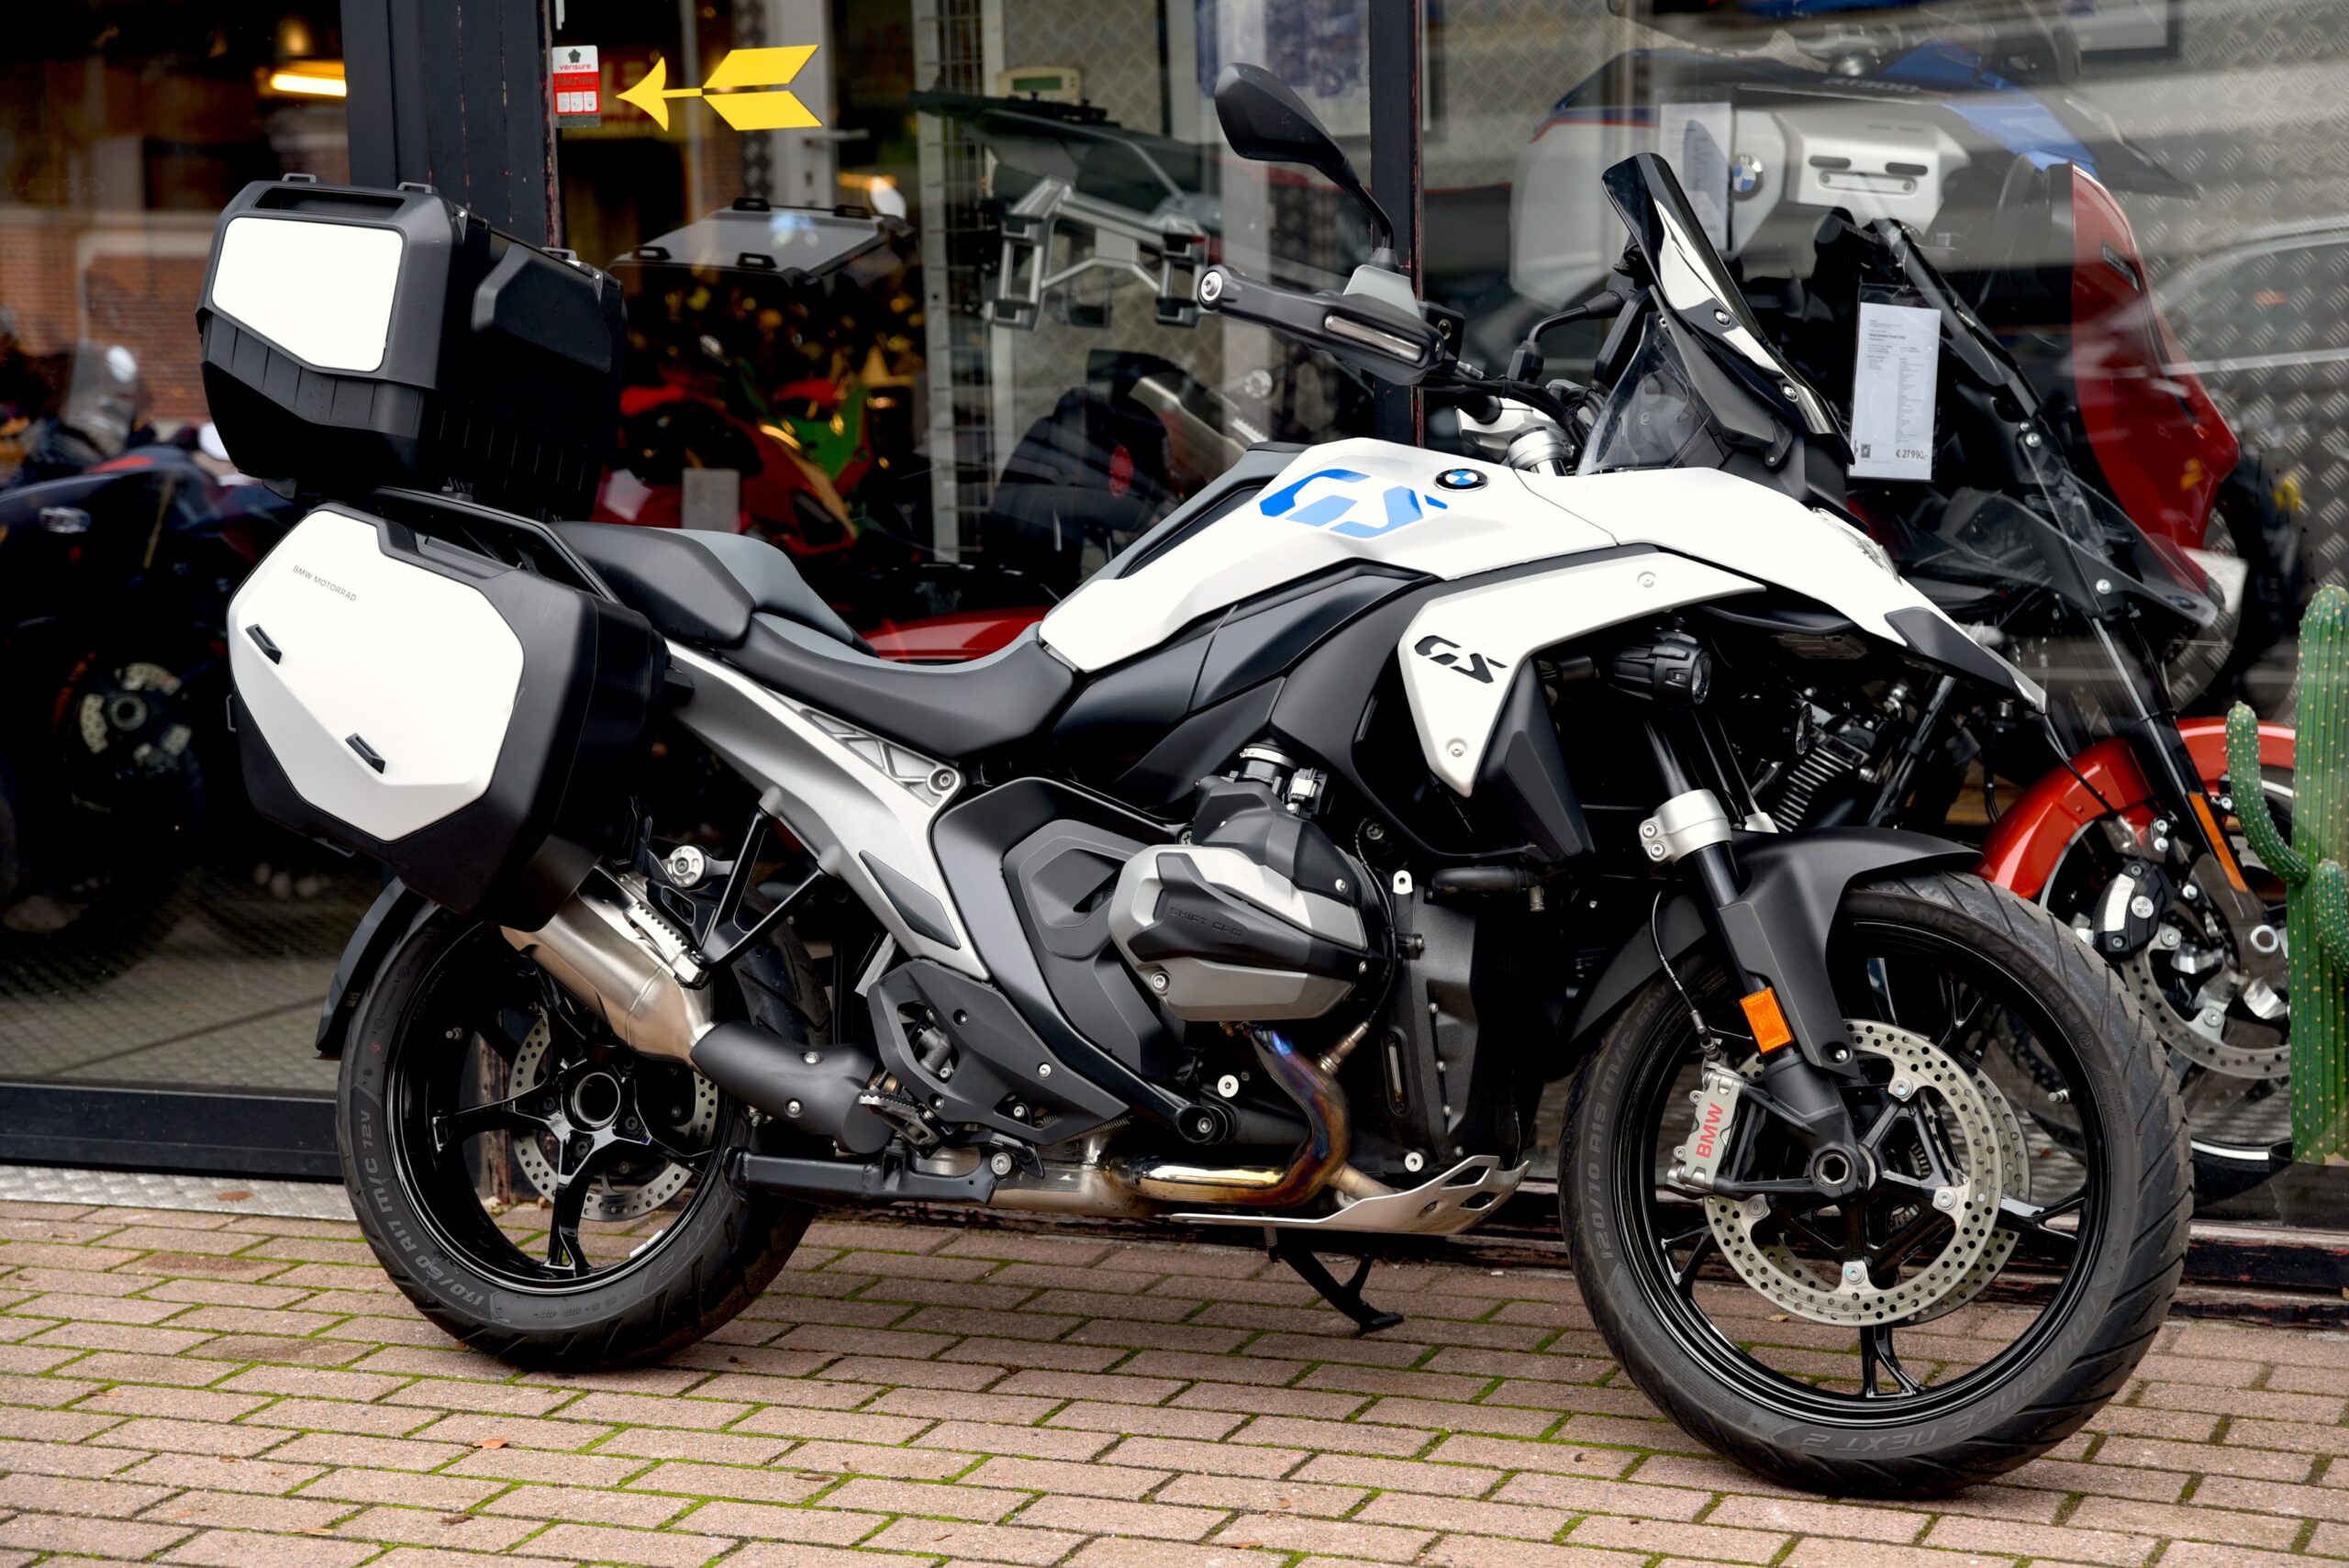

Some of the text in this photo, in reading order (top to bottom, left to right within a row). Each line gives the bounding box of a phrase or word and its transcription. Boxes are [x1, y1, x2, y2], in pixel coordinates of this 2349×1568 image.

[559, 63, 592, 72] verisure
[1260, 468, 1448, 539] GS
[293, 565, 357, 602] BMW MOTORRAD
[1414, 635, 1508, 684] GS
[359, 1108, 373, 1149] 72V
[1695, 1102, 1724, 1159] BMW
[364, 1157, 393, 1213] M/C
[387, 1220, 417, 1252] R17
[1586, 1165, 1614, 1262] 120/70
[1951, 1296, 2105, 1430] TOURANCE
[1835, 1429, 1937, 1452] NEXT
